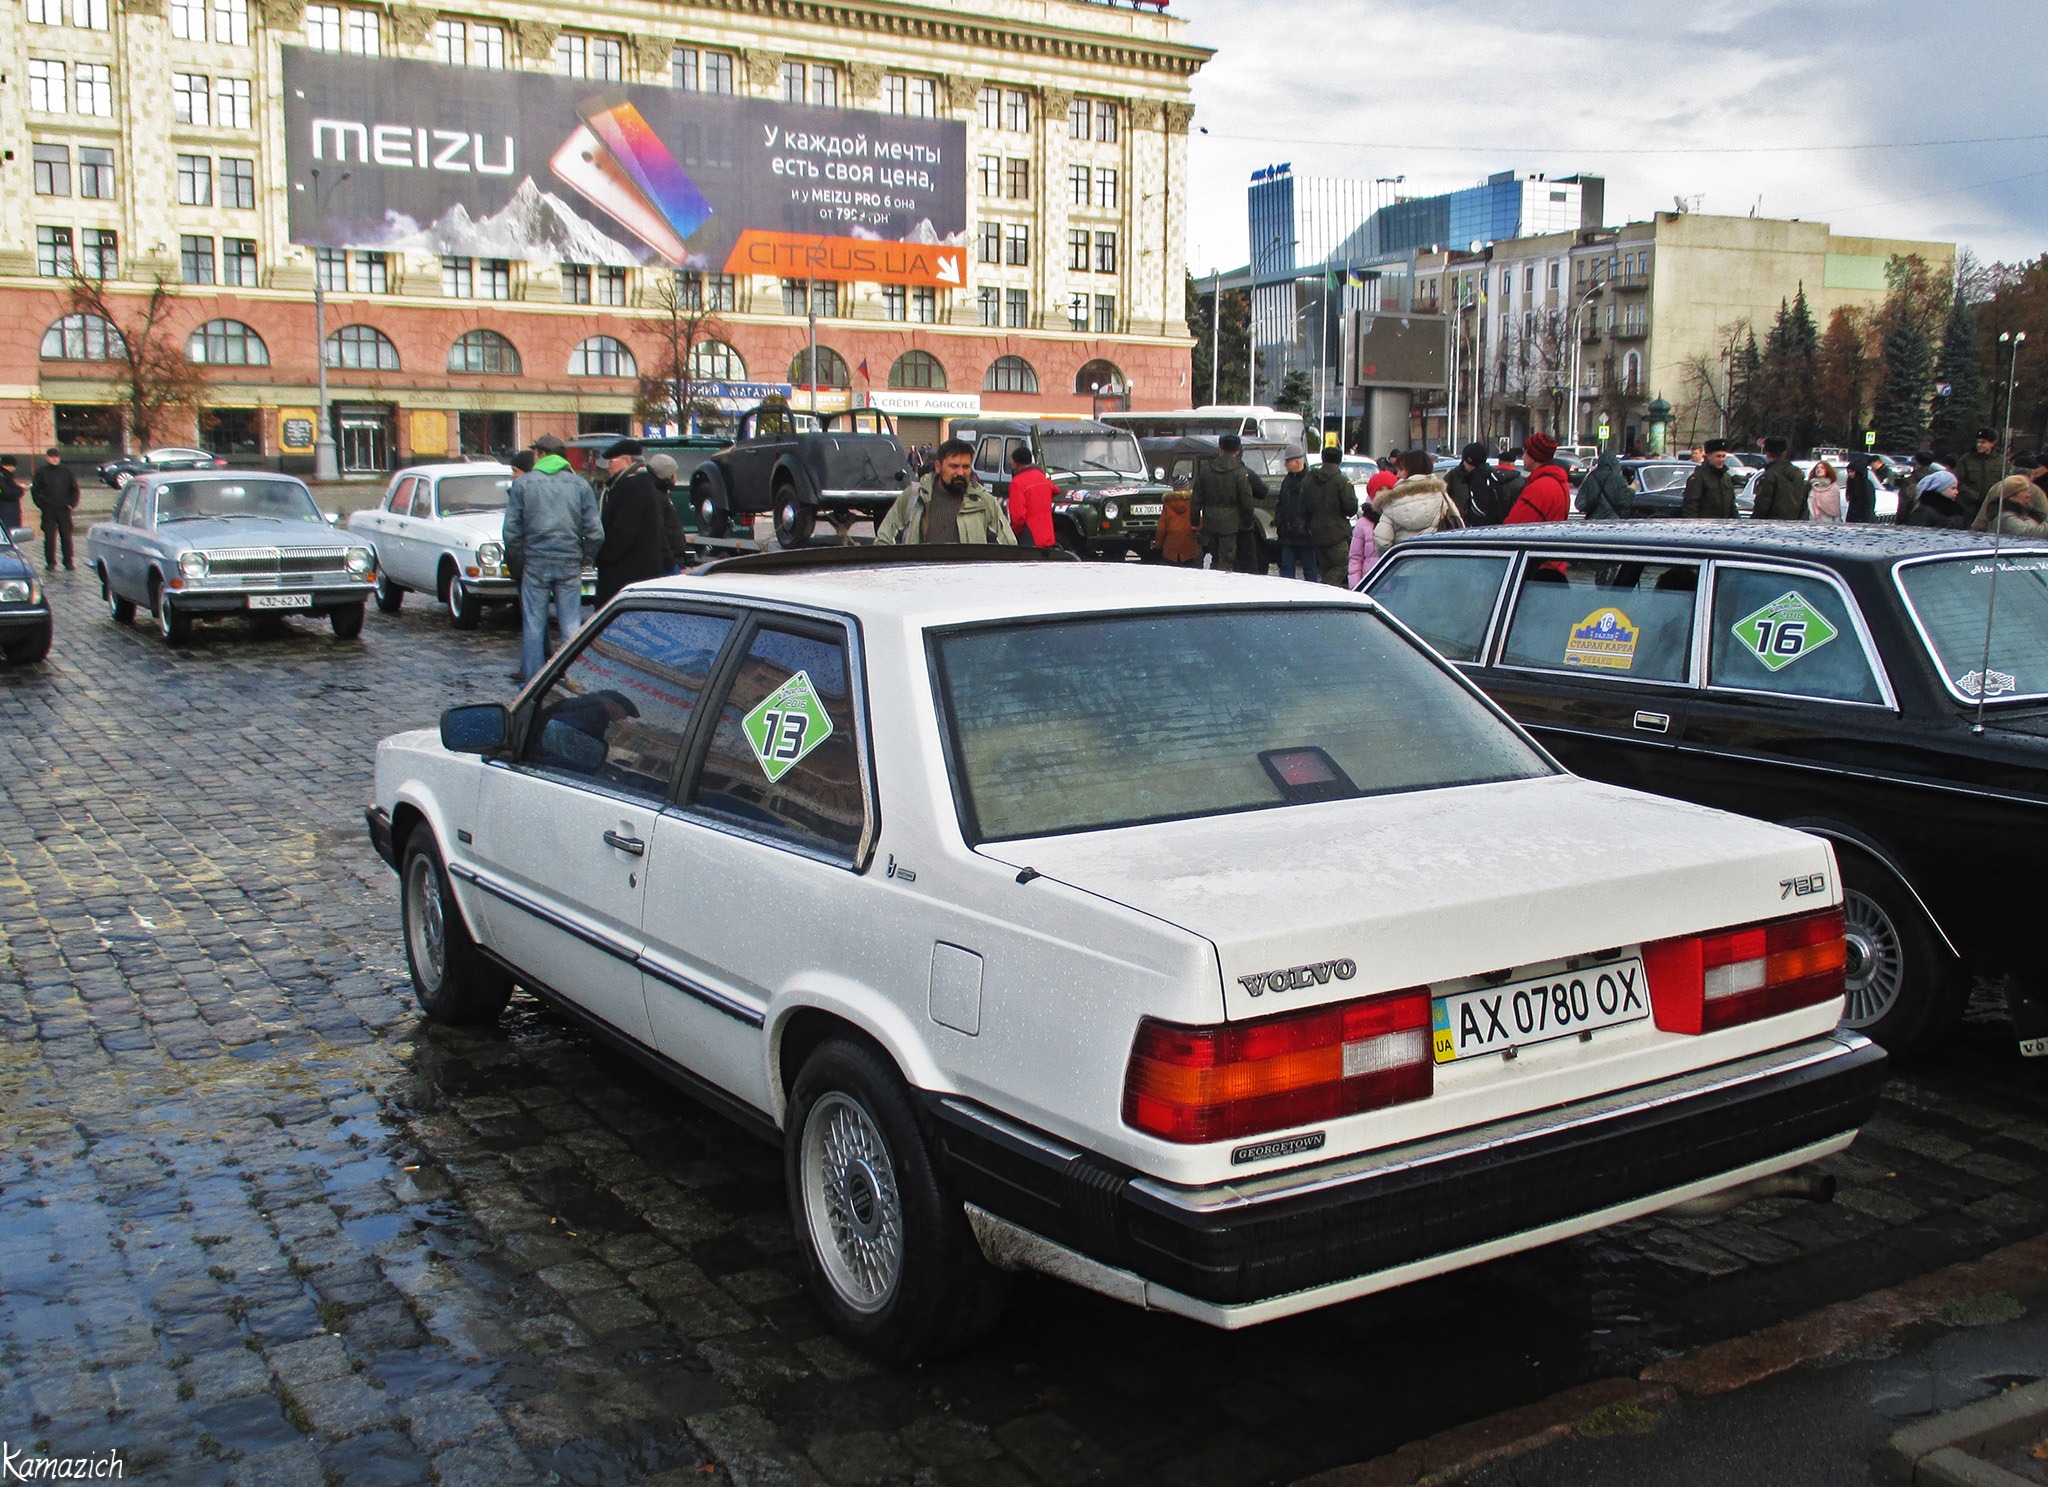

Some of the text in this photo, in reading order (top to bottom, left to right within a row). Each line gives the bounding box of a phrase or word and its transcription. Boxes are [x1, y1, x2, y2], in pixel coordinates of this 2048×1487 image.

[312, 119, 514, 174] MEIZU
[764, 124, 941, 164] У каждой мечты
[772, 157, 935, 192] есть своя цена,
[791, 189, 915, 210] и у MEIZU PRO 6 она
[820, 209, 833, 219] от
[749, 242, 929, 275] CITRUS.UA
[924, 400, 976, 410] AGRICOLE
[1602, 617, 1613, 628] 16
[1779, 611, 1803, 619] 2016
[1570, 640, 1633, 652] СТАРАЯ КАРТА
[1756, 621, 1806, 656] 16
[786, 700, 807, 709] 2016
[763, 712, 808, 760] 13
[1779, 873, 1825, 900] 780
[1237, 957, 1357, 997] VOLVO
[1460, 967, 1642, 1048] AX 0780 OX
[1436, 1038, 1452, 1053] UA
[1239, 1135, 1322, 1159] GEORGETOWN
